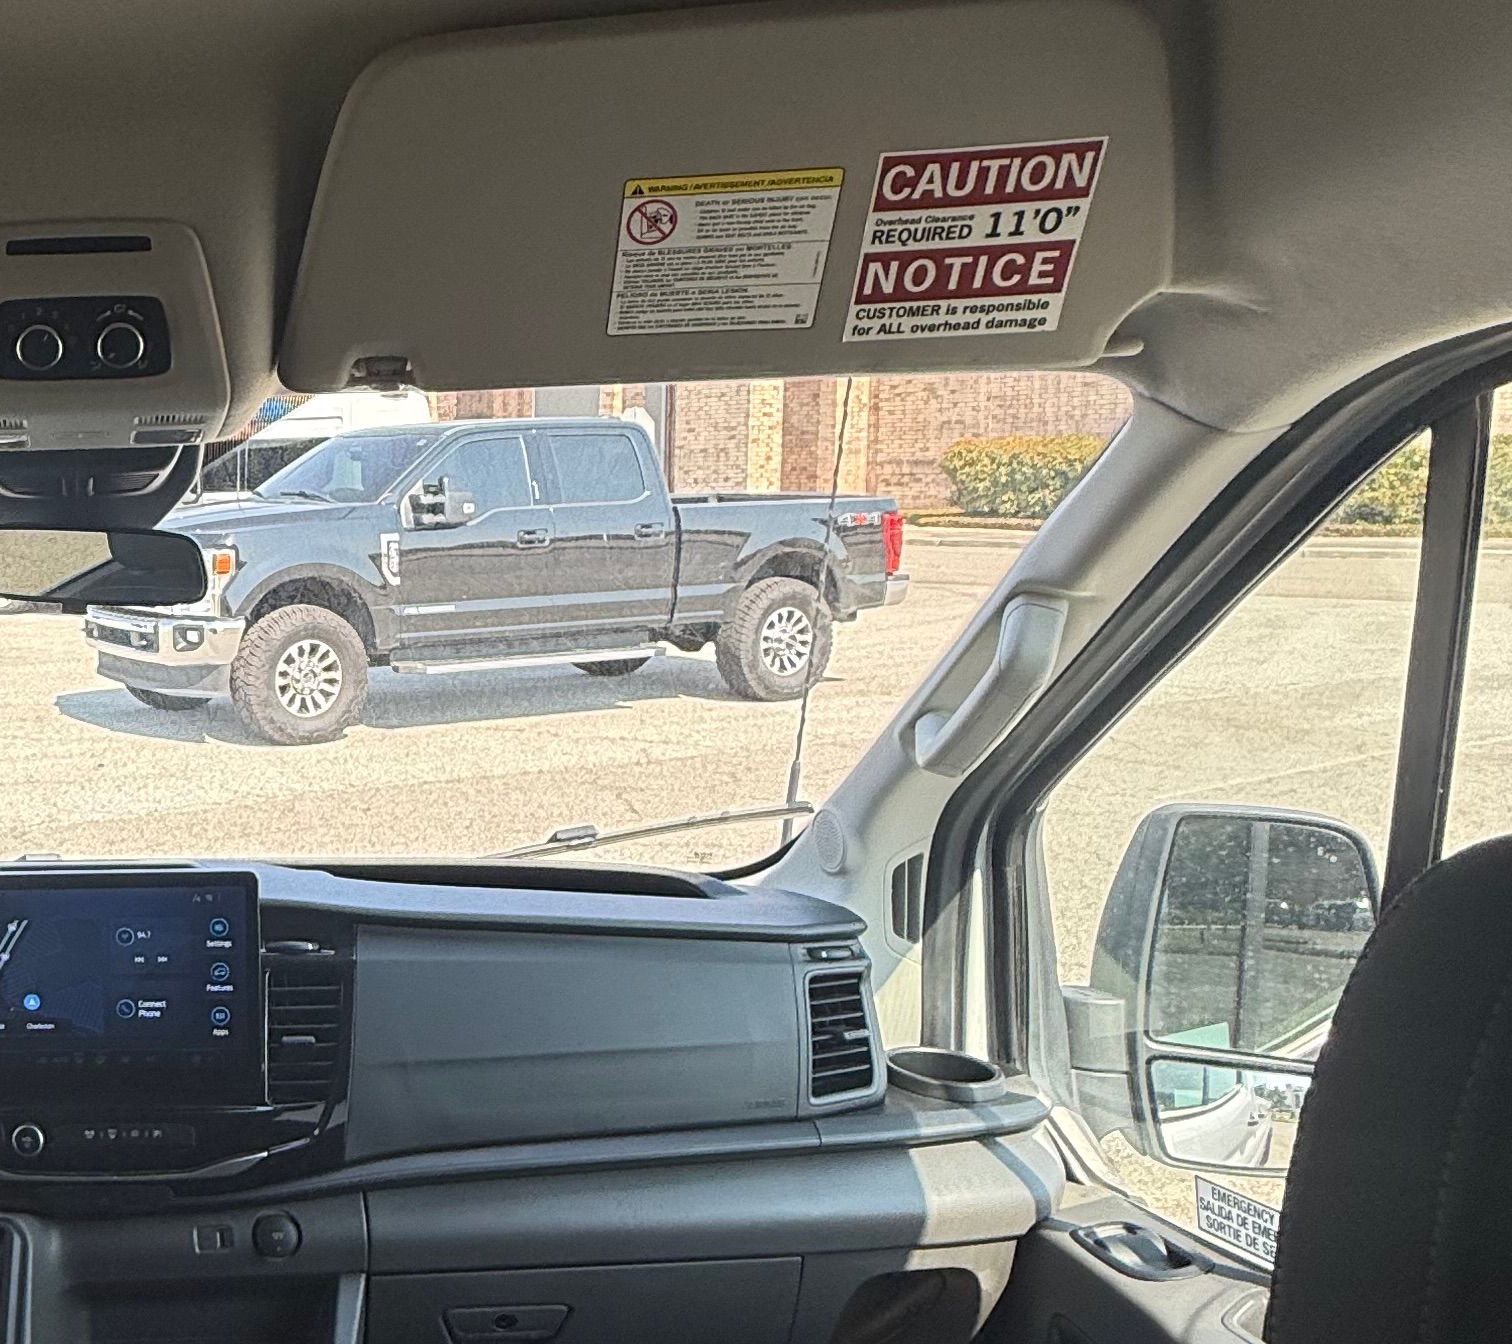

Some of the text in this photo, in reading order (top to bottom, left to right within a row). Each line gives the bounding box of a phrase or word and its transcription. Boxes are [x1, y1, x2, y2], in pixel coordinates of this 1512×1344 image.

[882, 151, 1096, 201] CAUTION
[871, 224, 973, 246] REQUIRED
[874, 214, 975, 227] Overhead Clearance
[863, 250, 1061, 296] NOTICE
[852, 315, 1048, 336] for ALL overhead damage
[855, 298, 1050, 321] CUSTOMER is responsible
[1199, 1196, 1234, 1223] SALIDA
[1236, 1213, 1250, 1231] DE
[1211, 1186, 1275, 1226] EMERGENCY
[1206, 1214, 1243, 1243] SORTIE
[1245, 1232, 1260, 1251] DE
